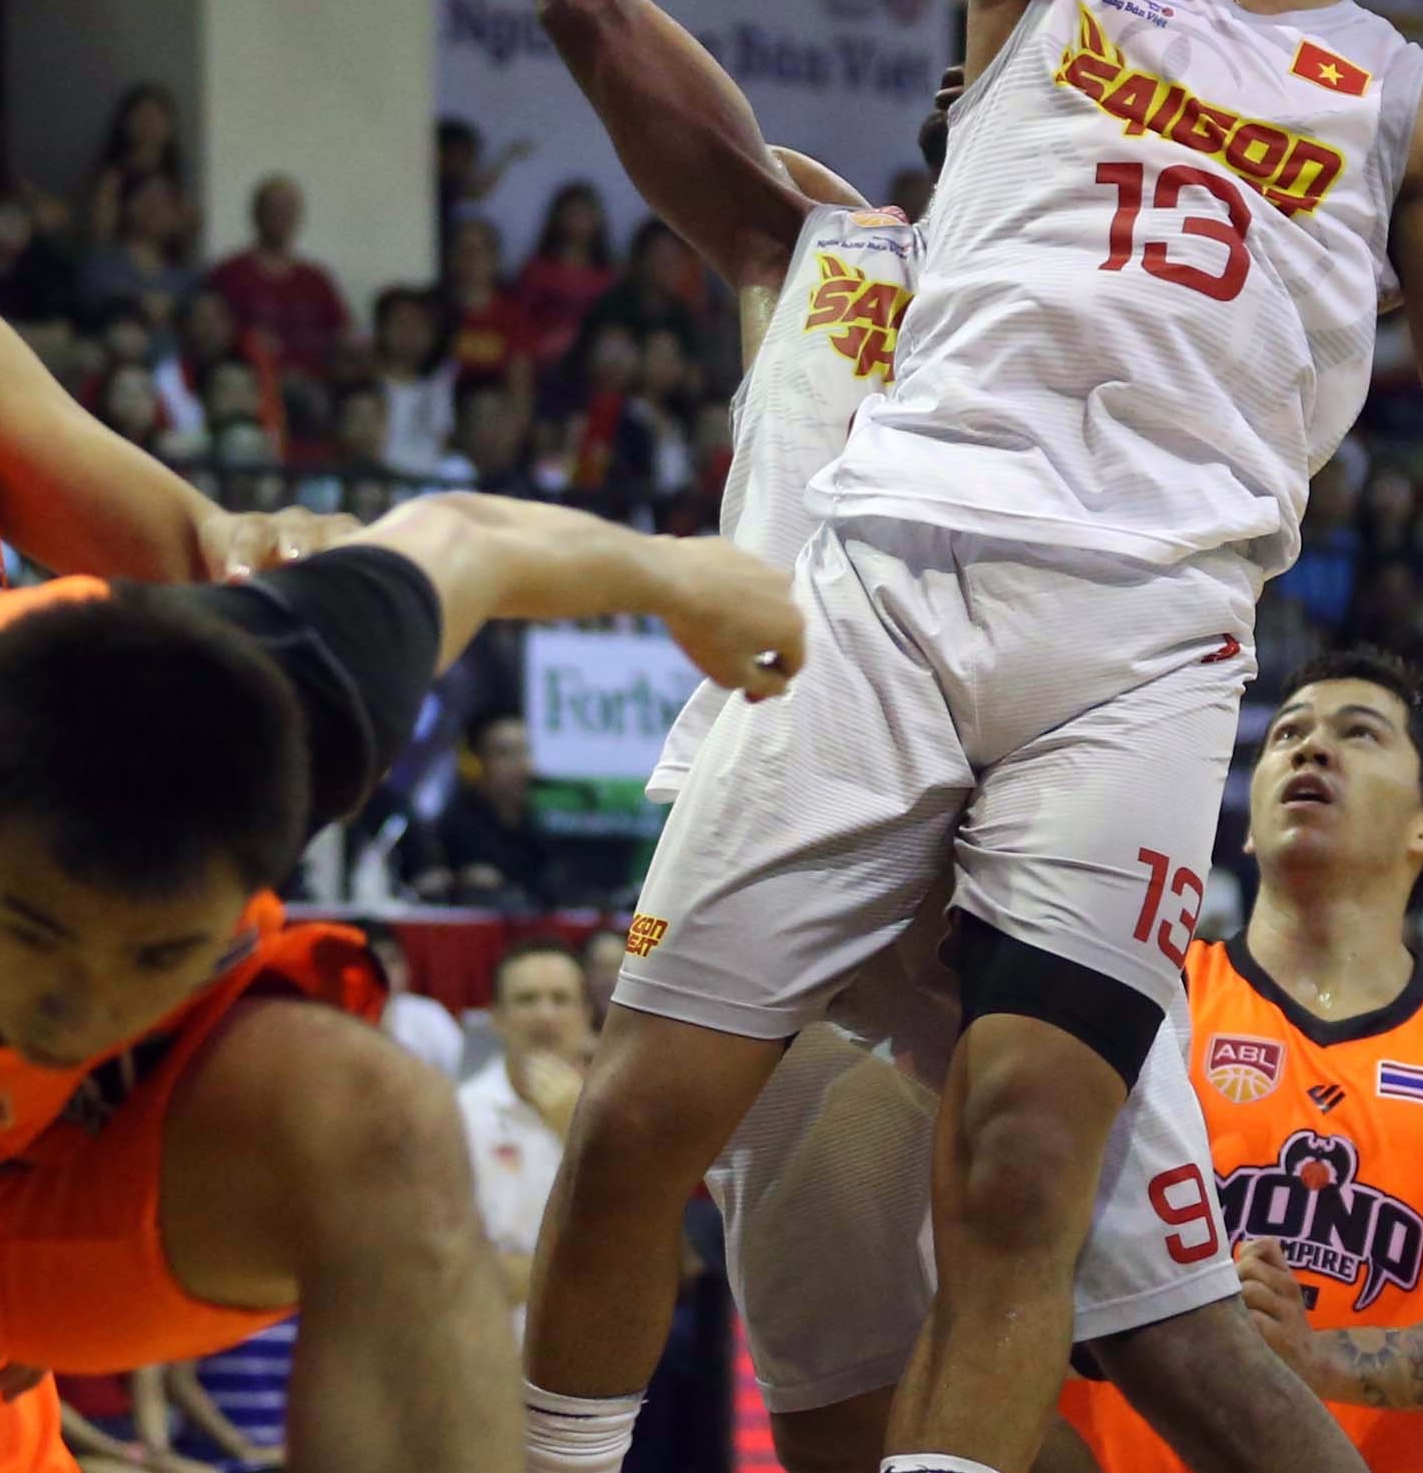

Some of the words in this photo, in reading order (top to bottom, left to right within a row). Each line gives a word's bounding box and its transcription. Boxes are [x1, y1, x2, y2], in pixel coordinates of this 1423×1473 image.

[1059, 50, 1345, 203] SAIGON
[1095, 162, 1253, 302] 13
[1133, 847, 1206, 972] 13
[1213, 1041, 1277, 1070] ABL
[1147, 1162, 1220, 1264] 9
[1280, 1237, 1356, 1279] MPIRE
